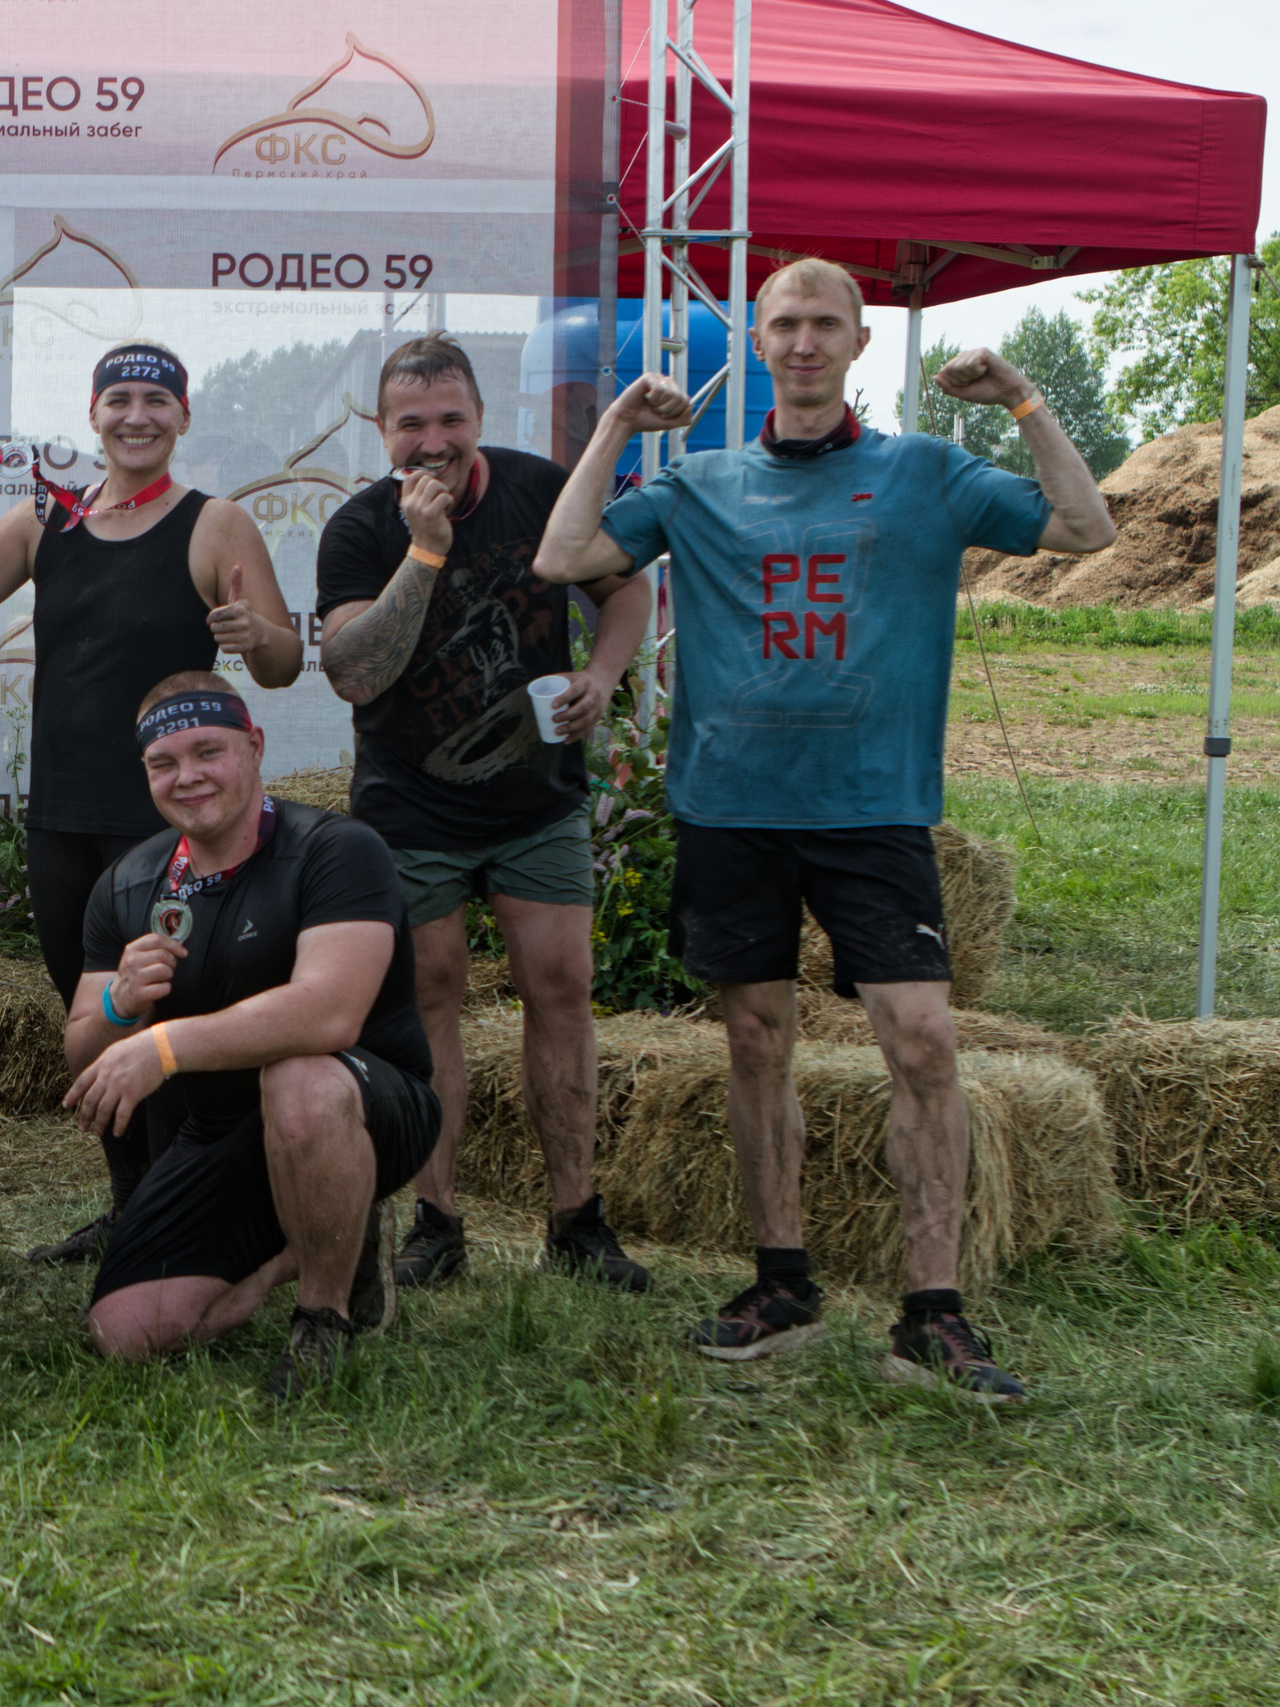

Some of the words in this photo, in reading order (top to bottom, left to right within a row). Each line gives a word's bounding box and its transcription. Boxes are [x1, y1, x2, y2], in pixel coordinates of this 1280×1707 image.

[95, 76, 145, 112] 59
[87, 121, 142, 137] забег
[255, 133, 347, 165] ФКС
[232, 168, 319, 179] Пермский
[326, 170, 367, 180] край
[212, 252, 369, 291] РОДЕО
[383, 254, 433, 289] 59
[105, 354, 157, 369] РОДЕО
[121, 366, 161, 380] 2272
[762, 554, 846, 604] PE
[761, 611, 846, 660] RM
[140, 701, 194, 732] РОДЕО
[200, 701, 222, 712] 59
[155, 717, 200, 738] 2291
